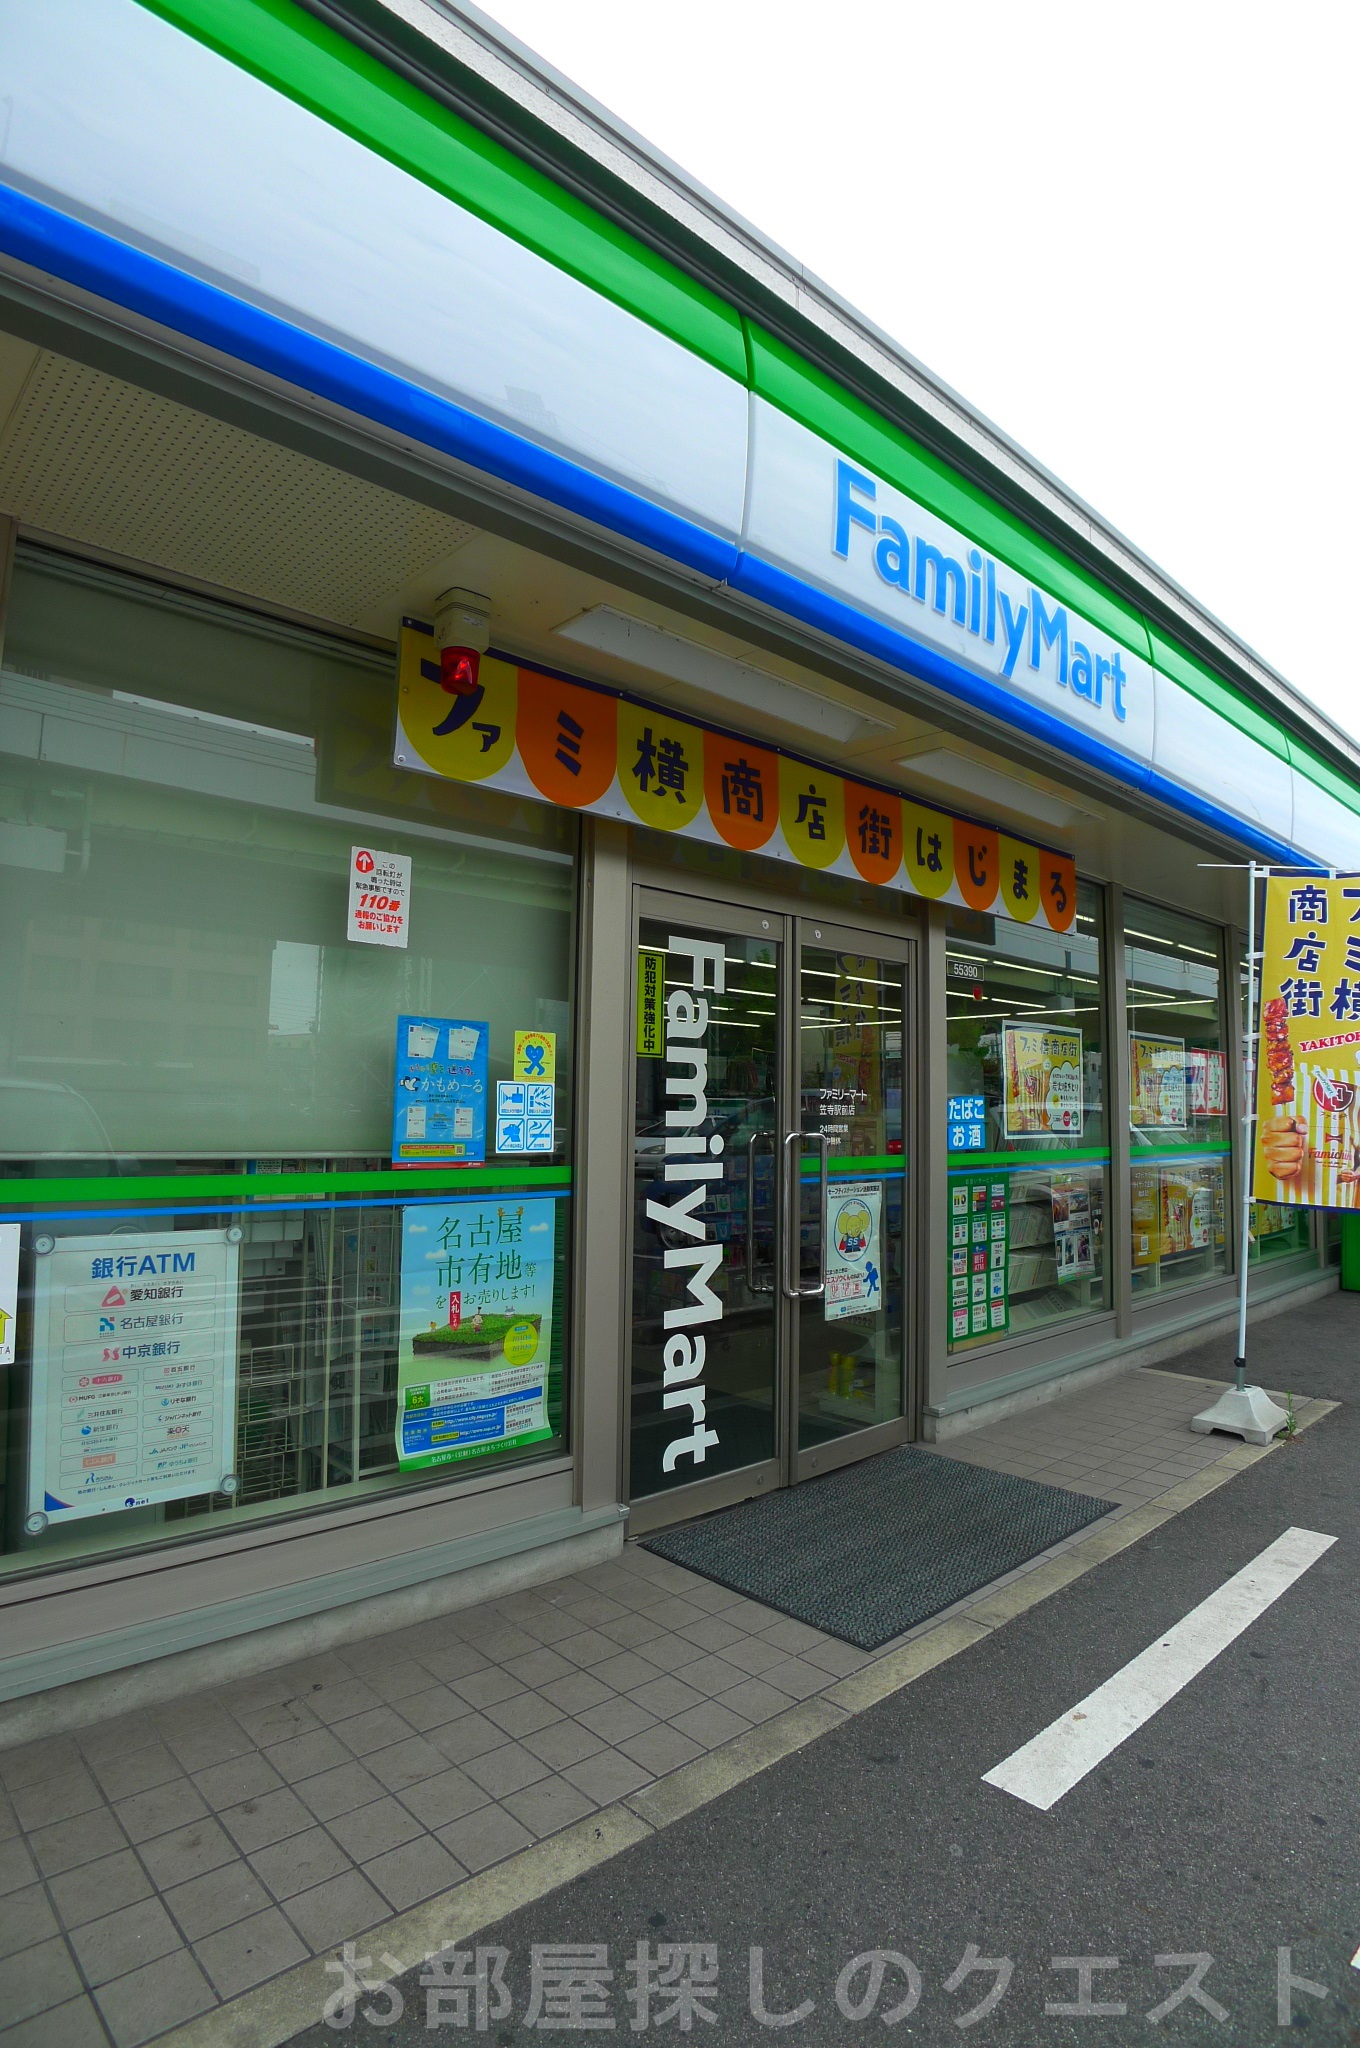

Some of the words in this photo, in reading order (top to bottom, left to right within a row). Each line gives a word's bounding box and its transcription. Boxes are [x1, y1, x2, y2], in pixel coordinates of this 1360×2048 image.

[833, 456, 1127, 723] FamilyMart
[376, 868, 403, 878] 回転灯が
[382, 861, 396, 869] この
[355, 881, 406, 896] 緊急事態ですので
[371, 876, 402, 887] 鳴った時は
[359, 893, 401, 911] 110番
[354, 909, 404, 925] 通報のご協力を
[358, 921, 400, 934] お願いします
[1280, 884, 1329, 1018] 商店街
[953, 963, 978, 978] 55390
[643, 956, 656, 1052] 防犯対策強化中
[1019, 1035, 1078, 1057] ファミ横商店街
[819, 1088, 868, 1101] ファミリーマート
[819, 1104, 856, 1116] 笠寺駅前店
[948, 1098, 985, 1120] たばこ
[819, 1124, 849, 1133] 24時間営業
[952, 1124, 982, 1147] お酒
[646, 935, 726, 1473] FamilyMart
[435, 1213, 523, 1251] 名古屋
[847, 1237, 859, 1246] SS
[91, 1251, 196, 1279] 銀行ATM
[435, 1248, 537, 1288] 市有地等
[130, 1286, 184, 1302] 愛知銀行
[435, 1295, 447, 1310] を
[119, 1312, 184, 1330] 名古屋銀行
[122, 1341, 181, 1359] 中京銀行
[170, 1396, 197, 1404] りそな銀行
[87, 1407, 124, 1419] 三井住友銀行
